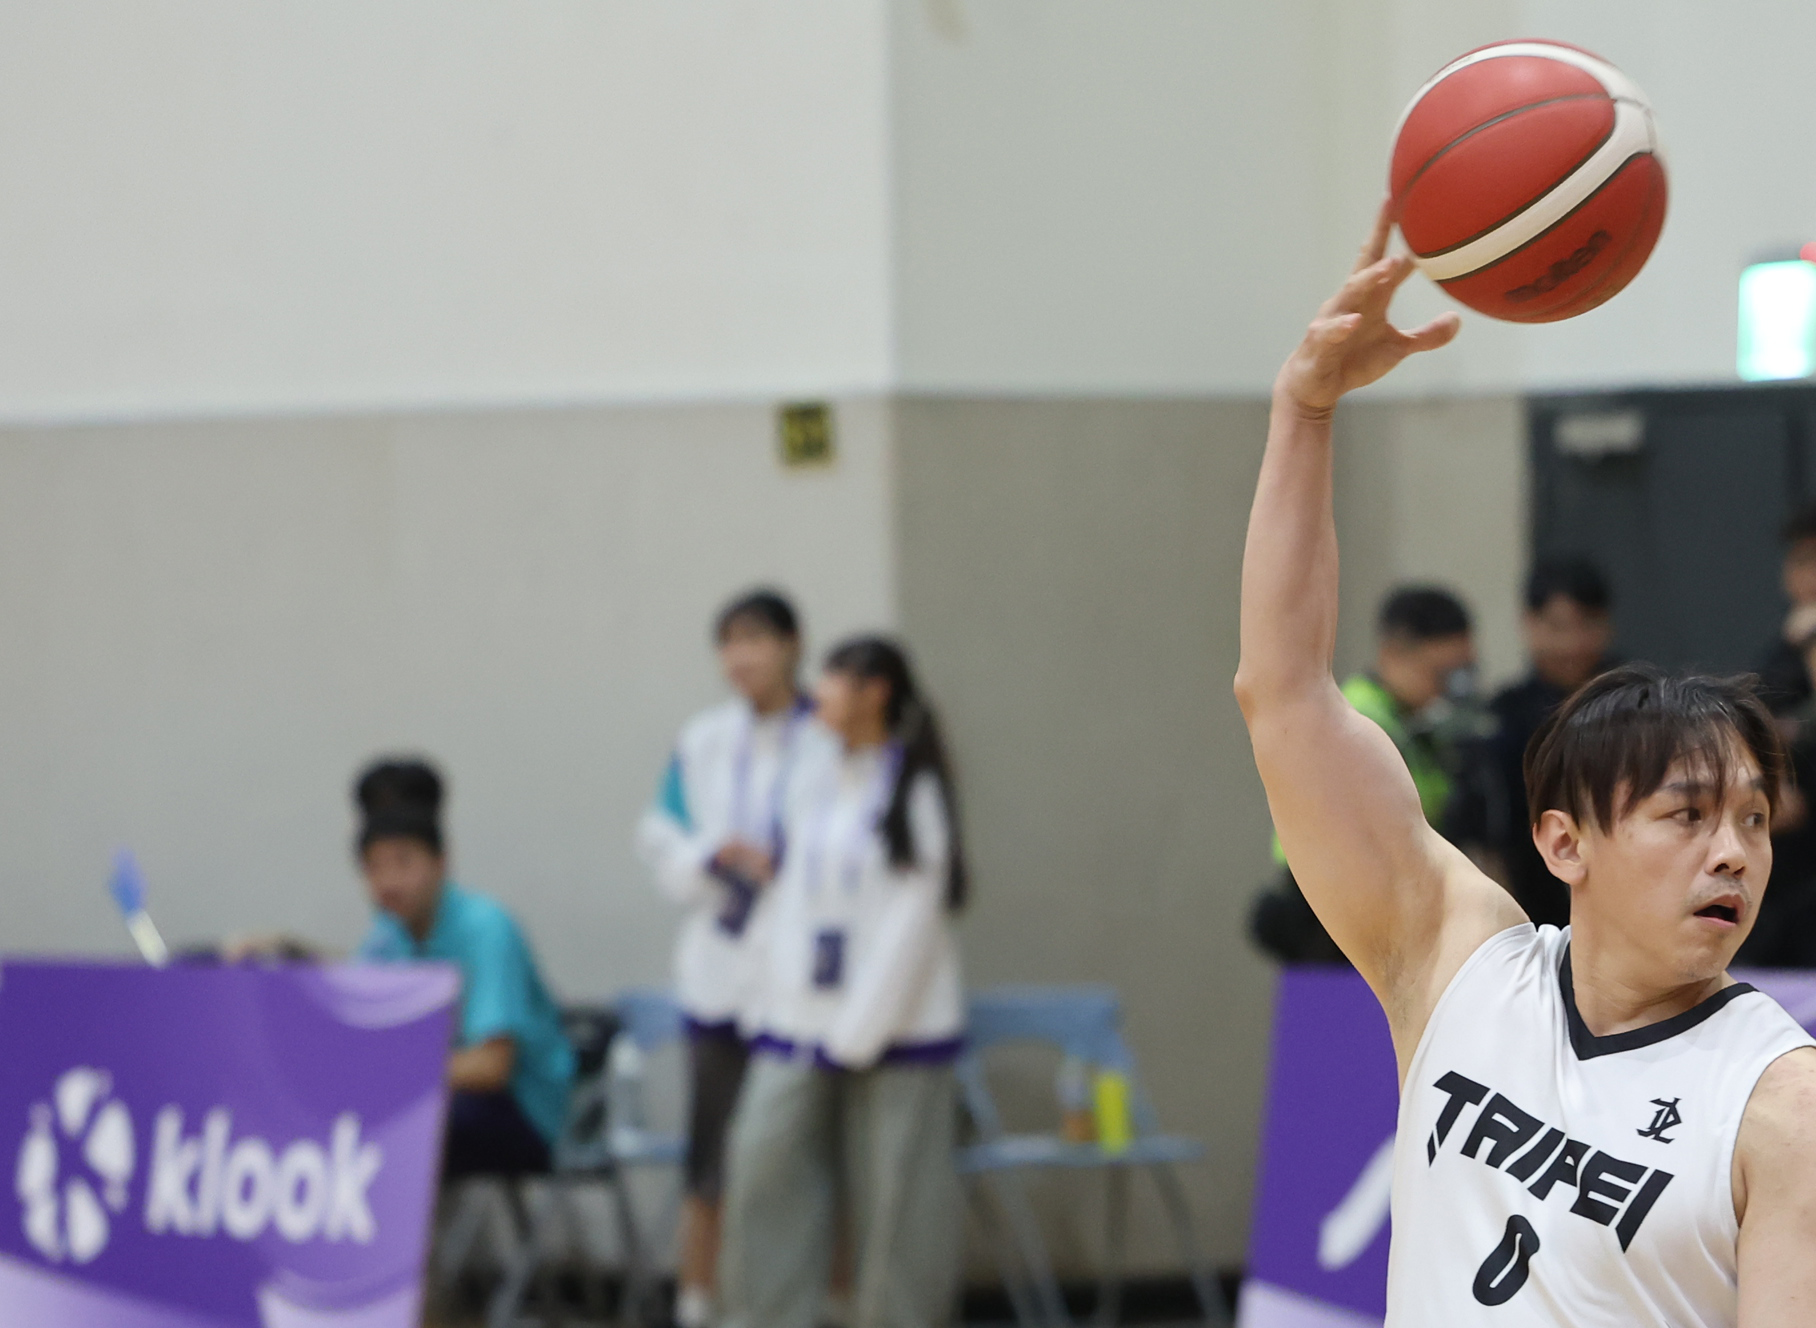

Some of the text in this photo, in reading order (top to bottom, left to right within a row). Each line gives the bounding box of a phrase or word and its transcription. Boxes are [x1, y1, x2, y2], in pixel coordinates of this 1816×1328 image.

[146, 1102, 383, 1244] klook
[1427, 1070, 1675, 1254] TAIPEI
[1473, 1214, 1540, 1306] 0
